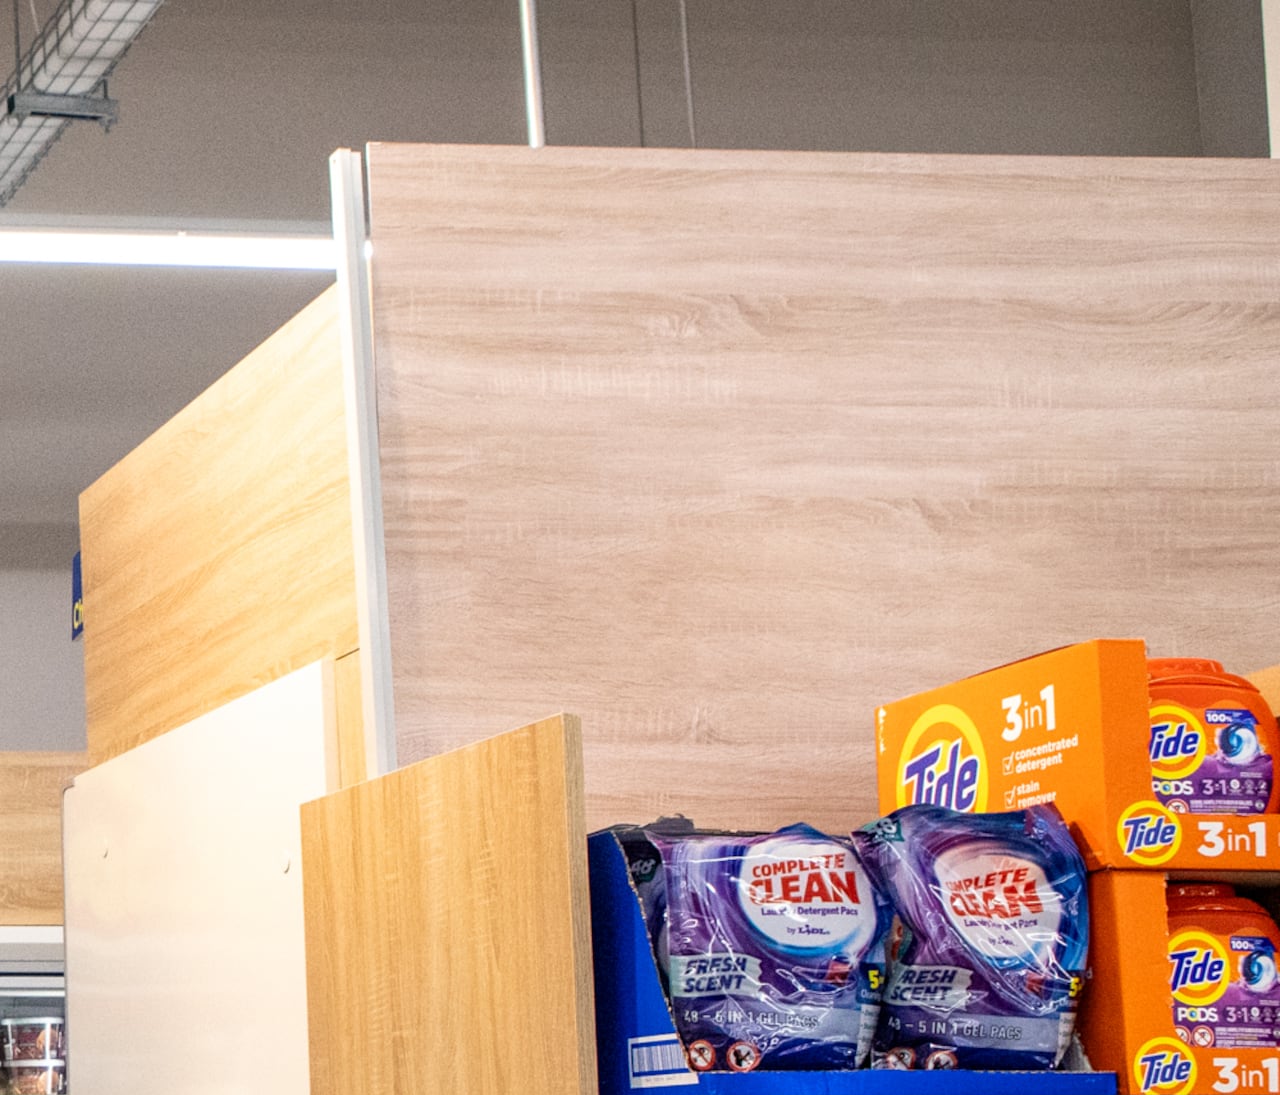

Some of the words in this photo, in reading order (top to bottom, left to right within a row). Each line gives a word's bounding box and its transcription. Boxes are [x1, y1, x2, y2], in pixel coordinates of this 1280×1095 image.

[1206, 713, 1233, 722] 100%
[1015, 735, 1079, 761] concentrated
[1149, 723, 1200, 761] Tide
[1015, 754, 1063, 773] detergent
[902, 738, 980, 813] Tide
[1017, 782, 1040, 796] stain
[1152, 780, 1194, 795] PODS
[1017, 792, 1057, 808] remover
[1123, 816, 1176, 855] Tide
[752, 854, 845, 878] COMPLETE
[749, 872, 860, 905] CLEAN
[950, 880, 1044, 919] CLEAN
[798, 907, 838, 916] Detergent
[840, 907, 858, 916] Pacs
[787, 927, 796, 935] by
[1231, 940, 1255, 950] 100%
[684, 958, 747, 974] FRESH
[1169, 950, 1224, 992] Tide
[684, 976, 745, 993] SCENT
[891, 986, 954, 1001] SCENT
[684, 1010, 698, 1022] 48
[727, 1012, 741, 1023] IN
[759, 1013, 781, 1024] GEL
[785, 1014, 818, 1026] PACS
[1177, 1007, 1218, 1022] PODS
[919, 1021, 927, 1033] 5
[932, 1021, 946, 1034] IN
[963, 1024, 986, 1037] GEL
[991, 1026, 1022, 1039] PACS
[1140, 1052, 1191, 1093] Tide
